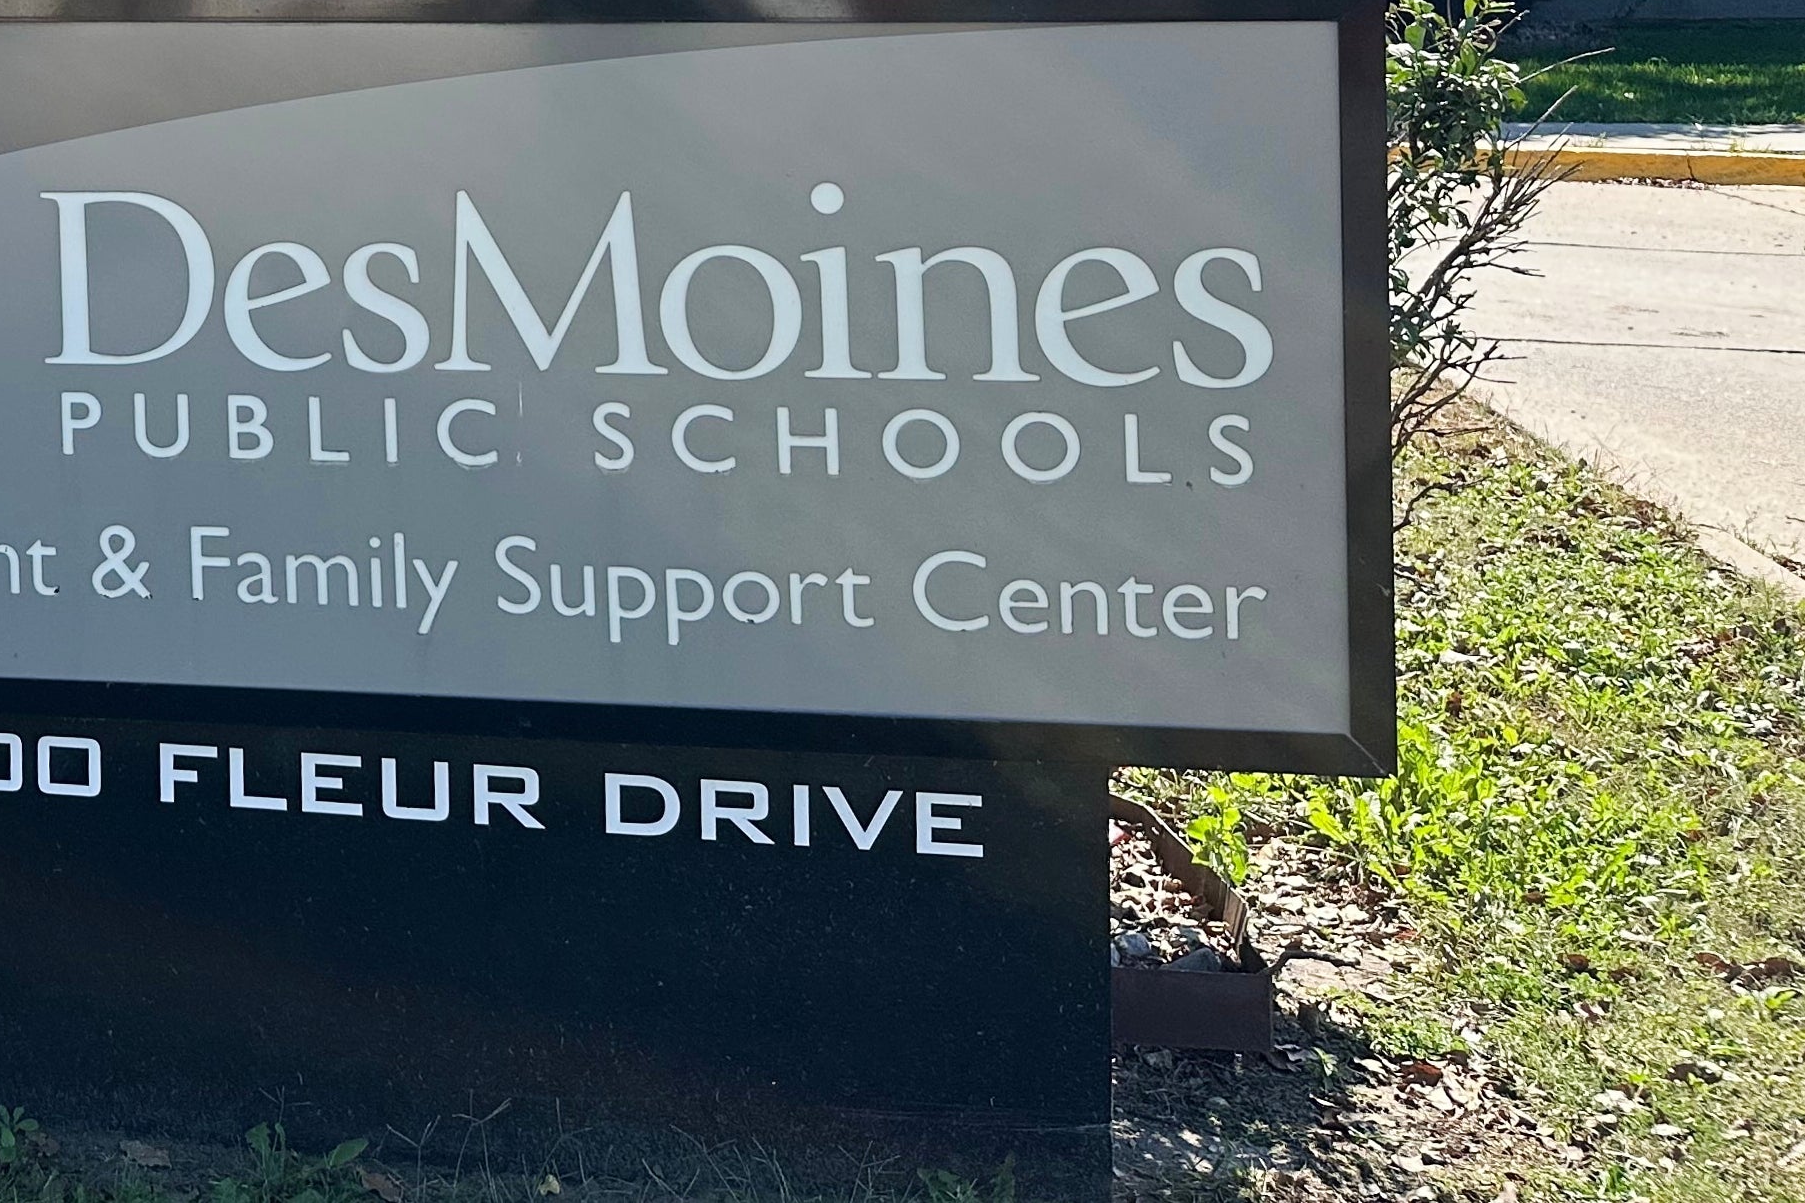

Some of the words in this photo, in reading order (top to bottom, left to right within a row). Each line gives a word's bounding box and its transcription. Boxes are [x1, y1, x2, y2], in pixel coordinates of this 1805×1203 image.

[61, 391, 499, 467] PUBLIC
[592, 402, 1255, 487] SCHOOLS
[90, 523, 152, 601] &
[190, 525, 459, 635] Family
[495, 535, 876, 646] Support
[911, 549, 1268, 640] Center
[159, 742, 547, 831] FLEUR
[604, 772, 984, 859] DRIVE
